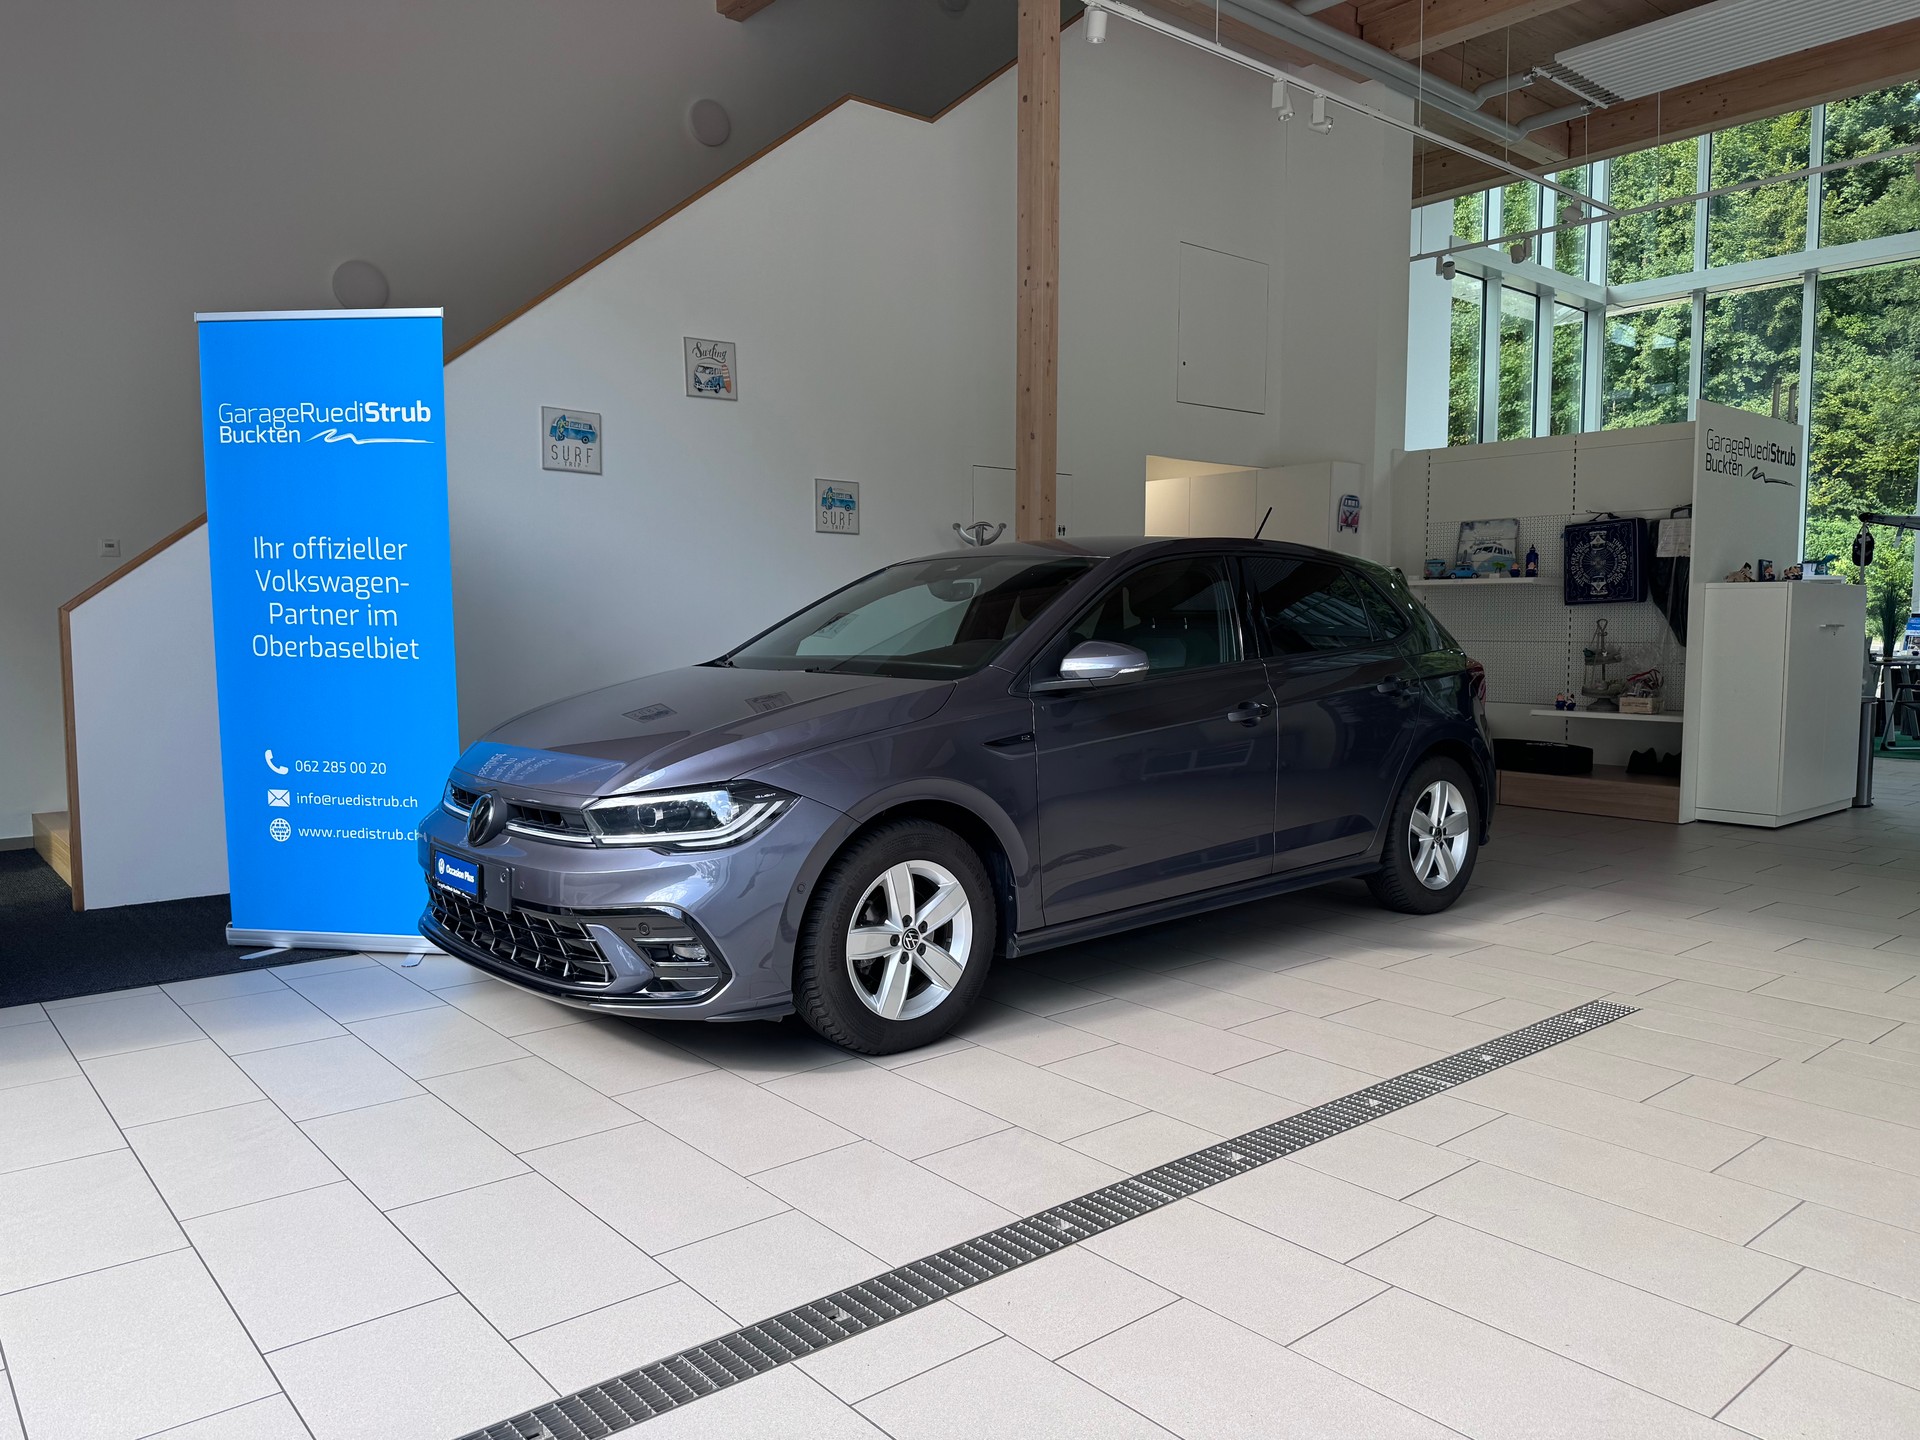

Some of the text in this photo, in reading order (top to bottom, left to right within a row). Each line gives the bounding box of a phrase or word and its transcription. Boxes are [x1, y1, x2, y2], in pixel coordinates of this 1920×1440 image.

[691, 341, 728, 364] Surfing
[218, 399, 432, 431] GarageRuediStrub
[219, 425, 301, 444] Buckten
[551, 444, 593, 464] SURF
[1706, 428, 1796, 467] GarageRuediStrub
[1705, 452, 1743, 477] Buckten
[822, 510, 853, 526] SURF
[254, 536, 408, 561] Ihr offizieller
[1612, 538, 1624, 551] TIME
[255, 569, 410, 600] Volkswagen-
[269, 602, 398, 627] Partner im
[252, 634, 420, 660] Oberbaselbiet
[295, 760, 387, 775] 062 285 00 20
[296, 792, 418, 808] info@ruedistrub.ch
